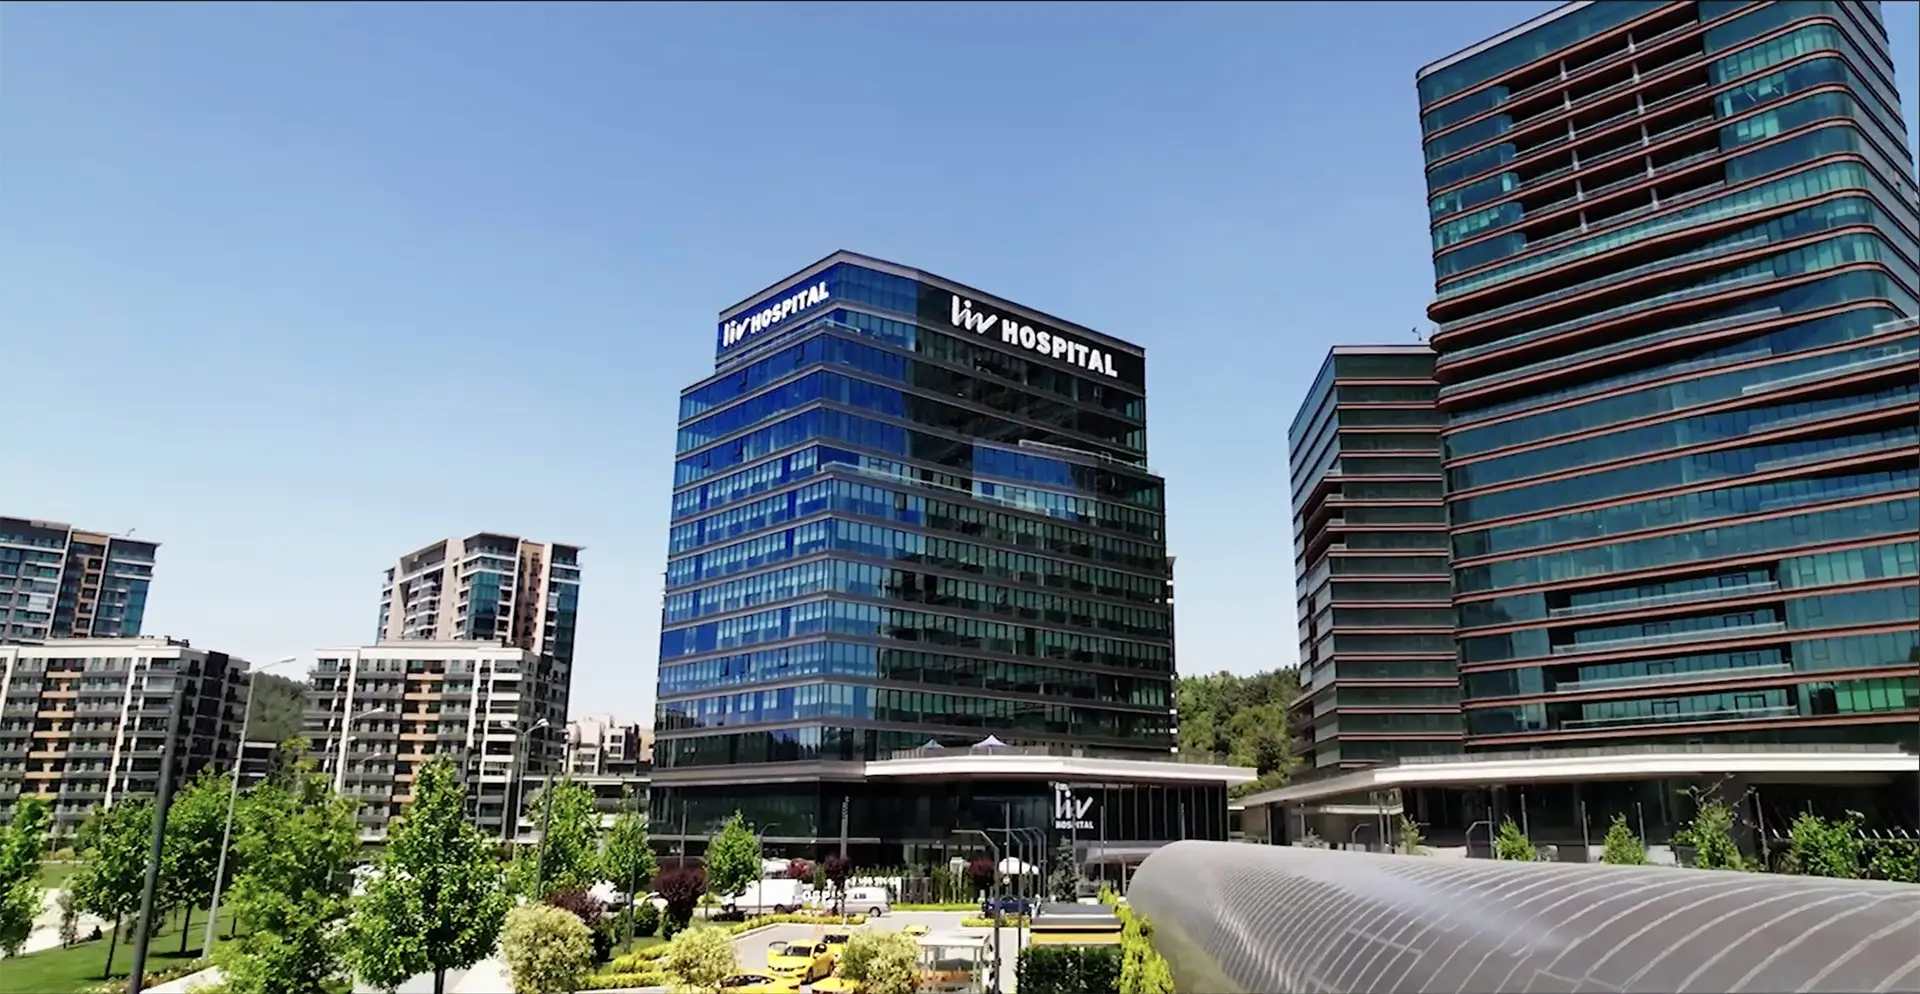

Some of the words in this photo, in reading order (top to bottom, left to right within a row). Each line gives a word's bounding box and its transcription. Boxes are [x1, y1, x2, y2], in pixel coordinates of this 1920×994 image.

[750, 281, 830, 334] HOSPITAL
[1001, 319, 1118, 378] HOSPITAL
[1055, 820, 1094, 829] HOSITAL
